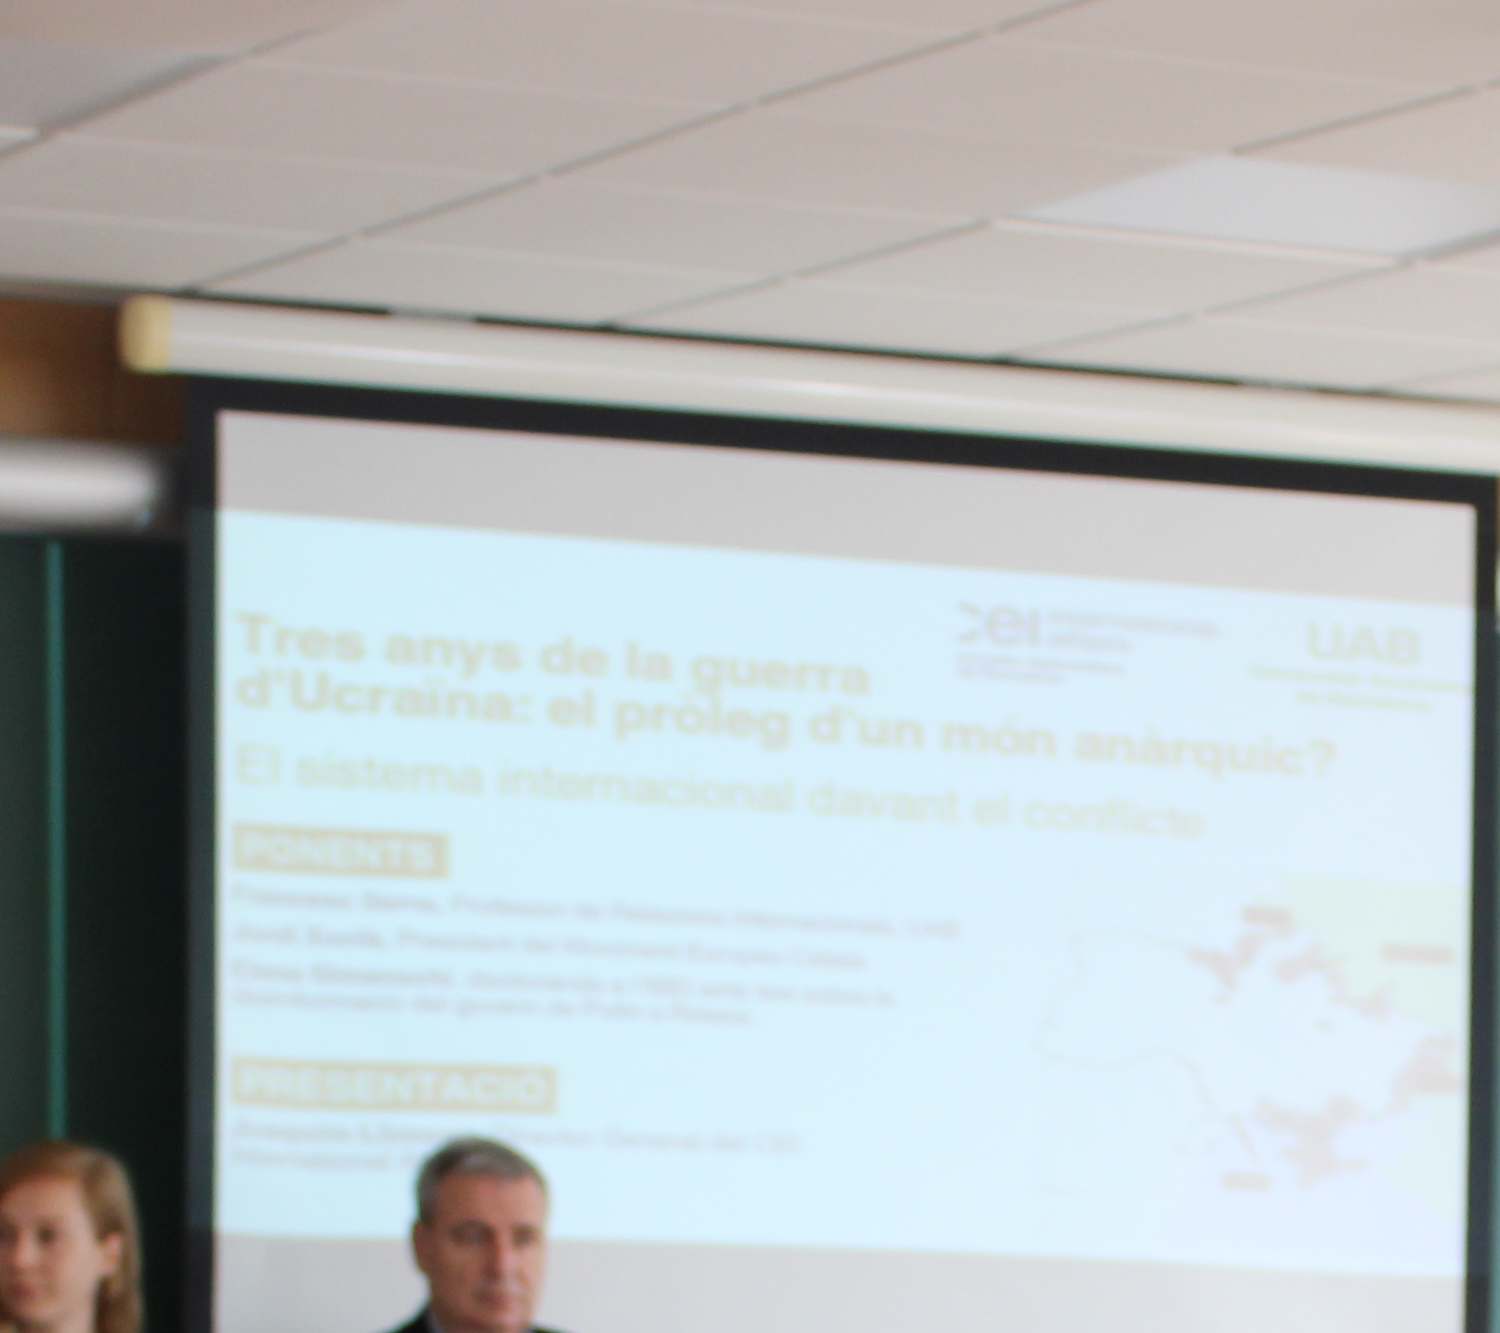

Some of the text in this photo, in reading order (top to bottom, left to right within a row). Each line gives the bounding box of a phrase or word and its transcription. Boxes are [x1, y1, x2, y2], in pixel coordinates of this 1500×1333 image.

[233, 611, 871, 699] Tres anys de la guerra
[1306, 621, 1422, 666] UAB
[234, 667, 1337, 777] d'Ucraïna: el pròleg d'un món anàrquic?
[236, 741, 1207, 840] El sistema internacional davant el conflicte
